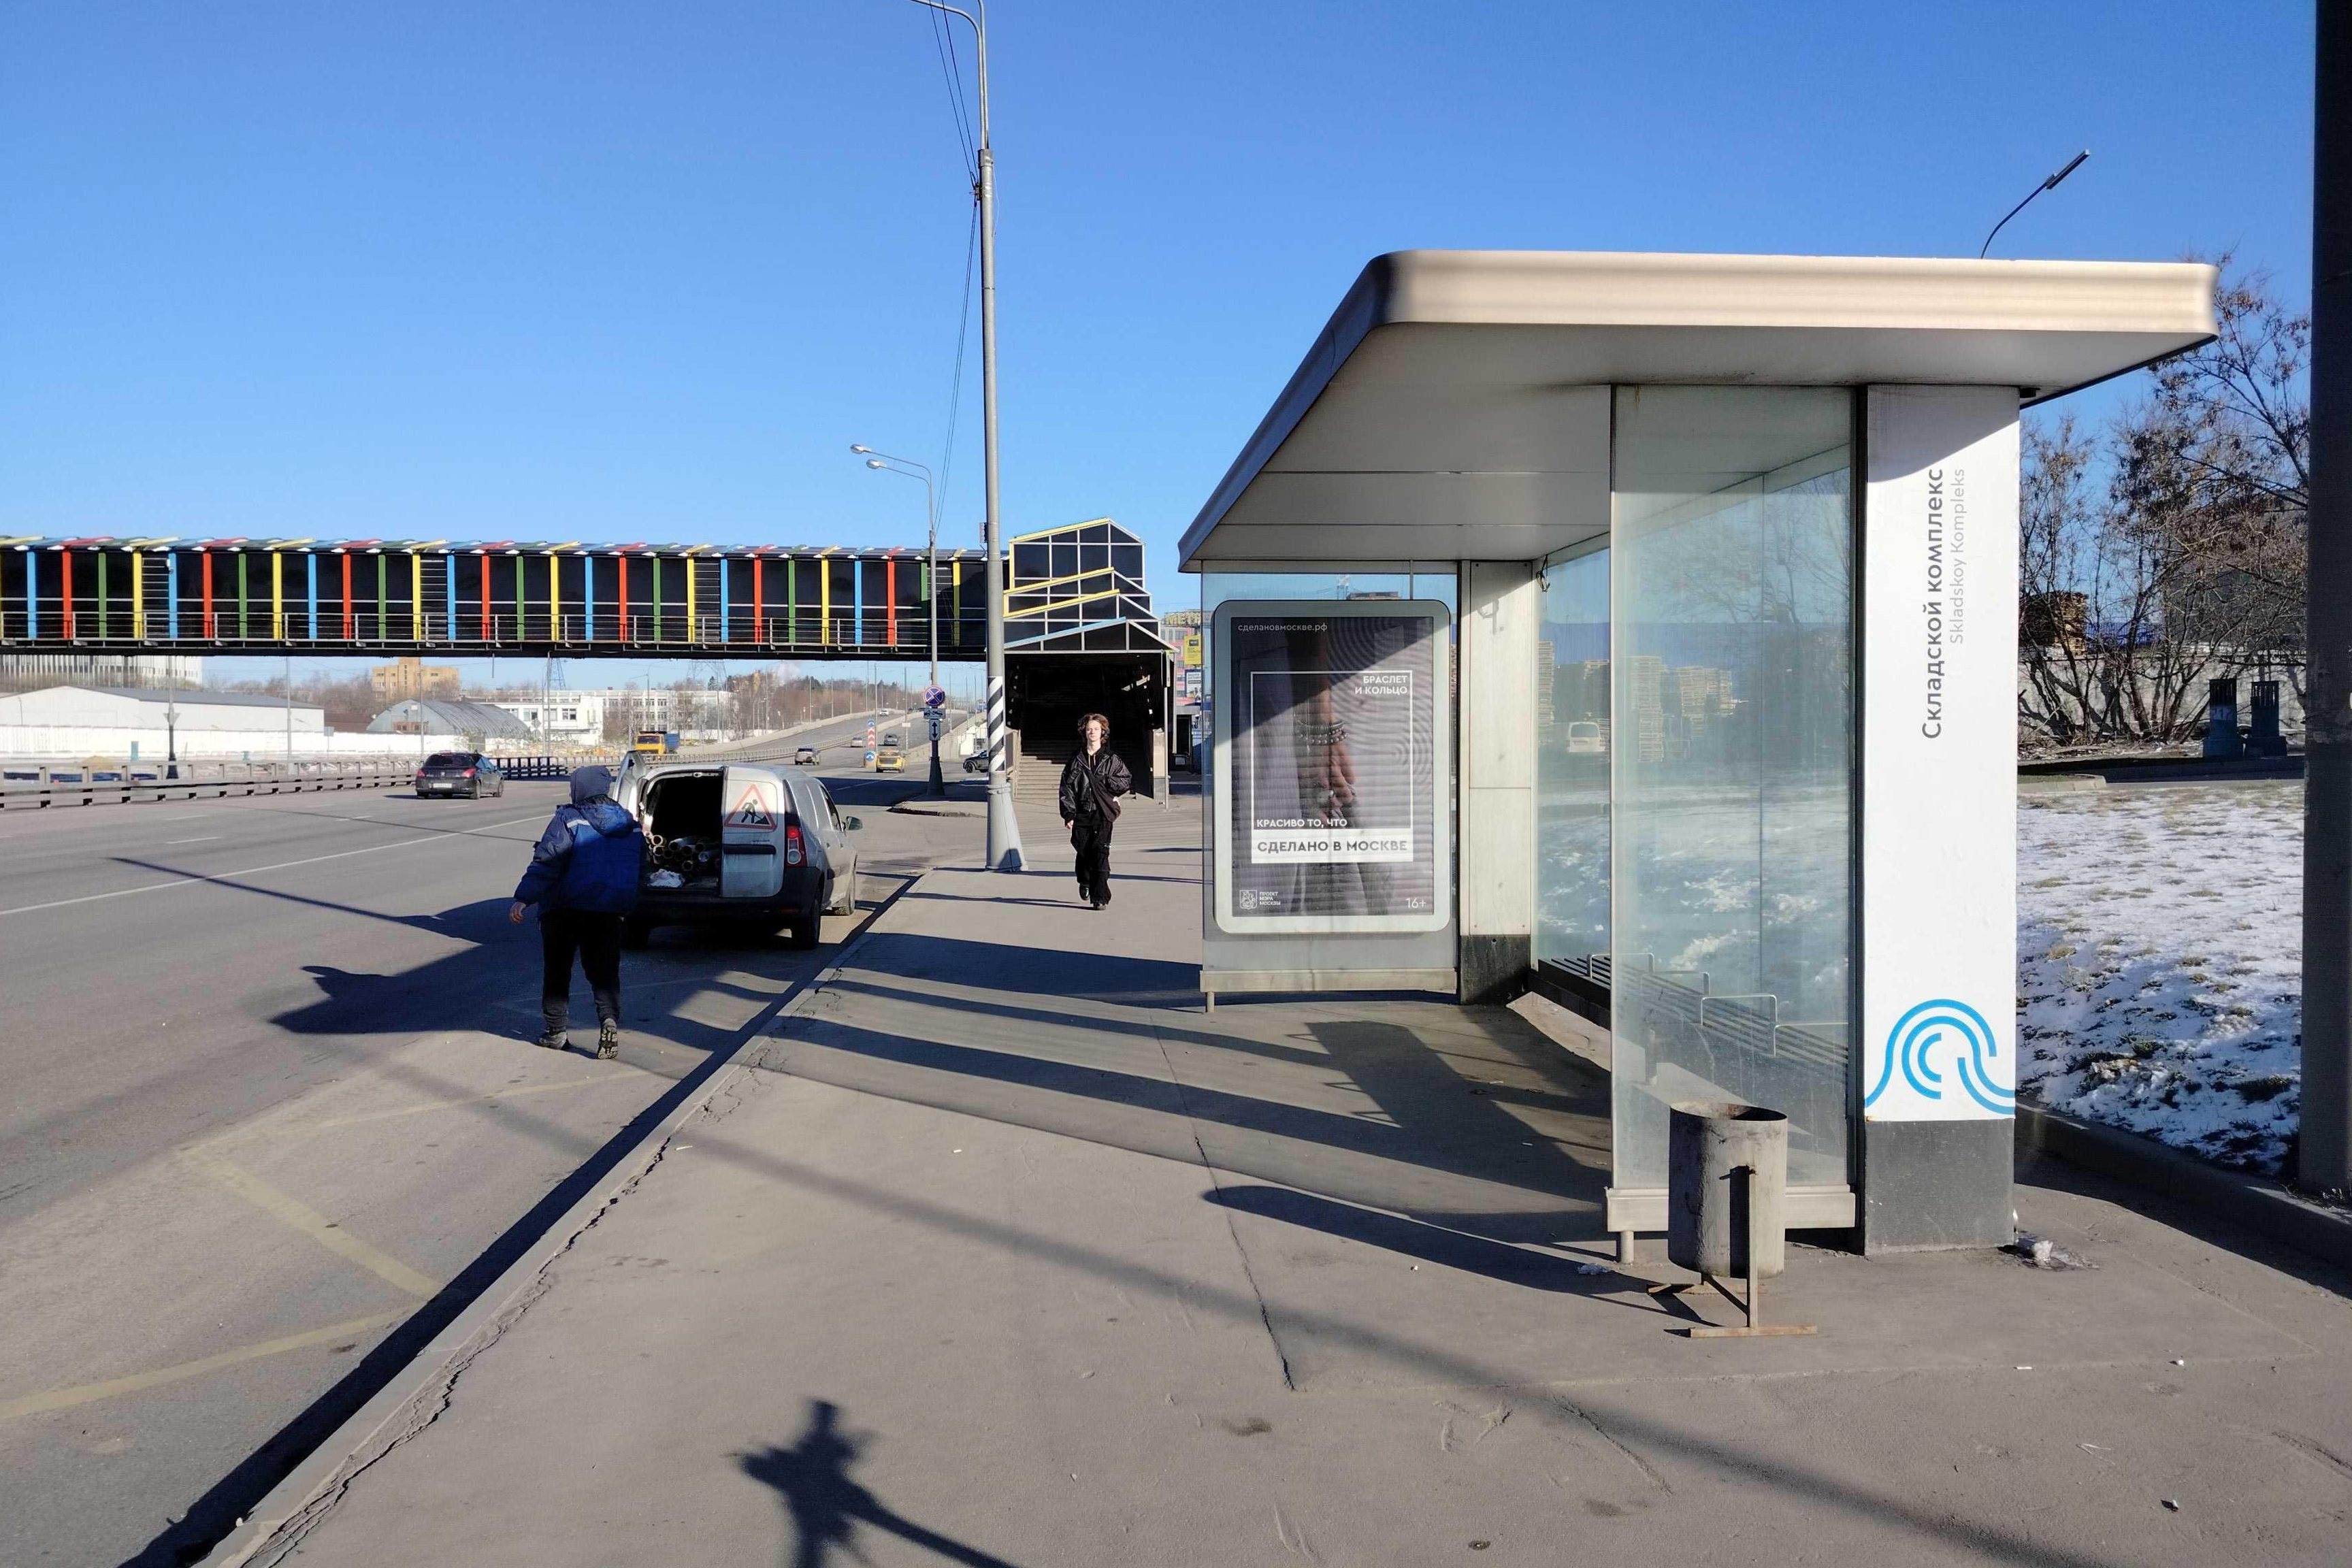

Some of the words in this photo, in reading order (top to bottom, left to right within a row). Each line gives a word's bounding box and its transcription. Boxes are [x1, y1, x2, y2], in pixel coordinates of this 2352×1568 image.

[1950, 468, 1968, 553] Kompleks
[1928, 468, 1944, 592] комплекс
[1949, 559, 1967, 644] Skladskoy
[1238, 622, 1328, 632] сделановмоскве.рф
[1922, 602, 1945, 739] Складской
[1363, 675, 1407, 684] БРАСЛЕТ
[1365, 686, 1407, 696] КОЛЬЦО
[1256, 819, 1305, 828] КРАСИВО
[1307, 819, 1324, 828] ТО,
[1326, 819, 1348, 827] ЧТО
[1257, 841, 1328, 853] СДЕЛАНО
[1333, 842, 1341, 851] В
[1346, 840, 1407, 851] МОСКВЕ
[1405, 898, 1426, 909] 16+
